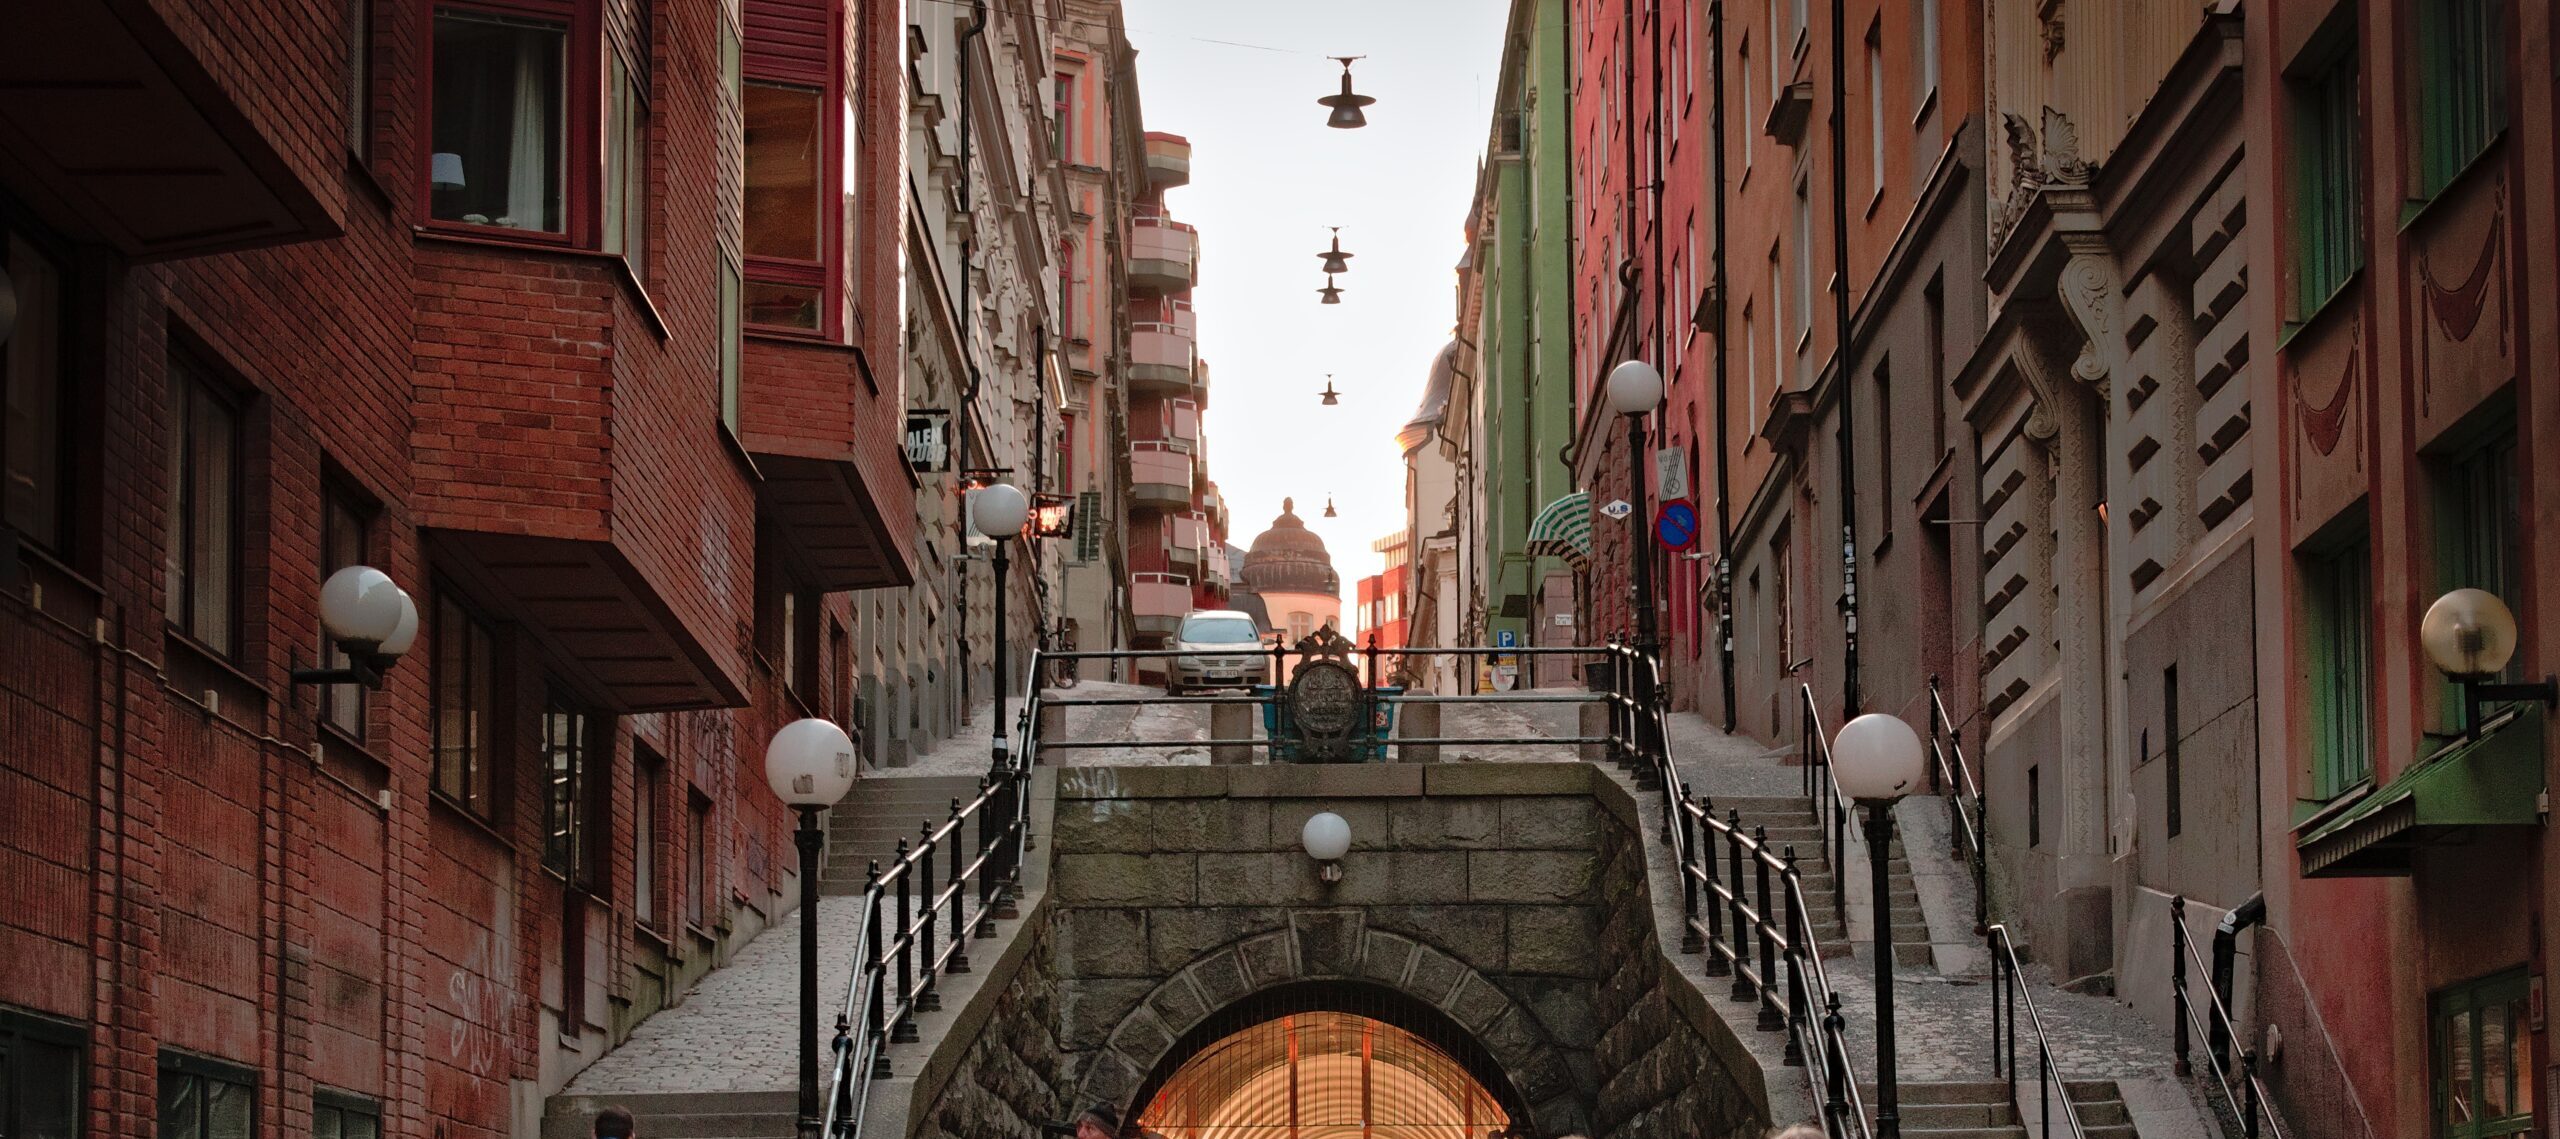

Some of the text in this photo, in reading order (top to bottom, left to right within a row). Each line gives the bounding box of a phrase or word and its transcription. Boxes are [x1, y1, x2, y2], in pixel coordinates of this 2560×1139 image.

[908, 427, 942, 448] ALEN
[909, 445, 947, 463] LUBB
[1502, 631, 1512, 646] P
